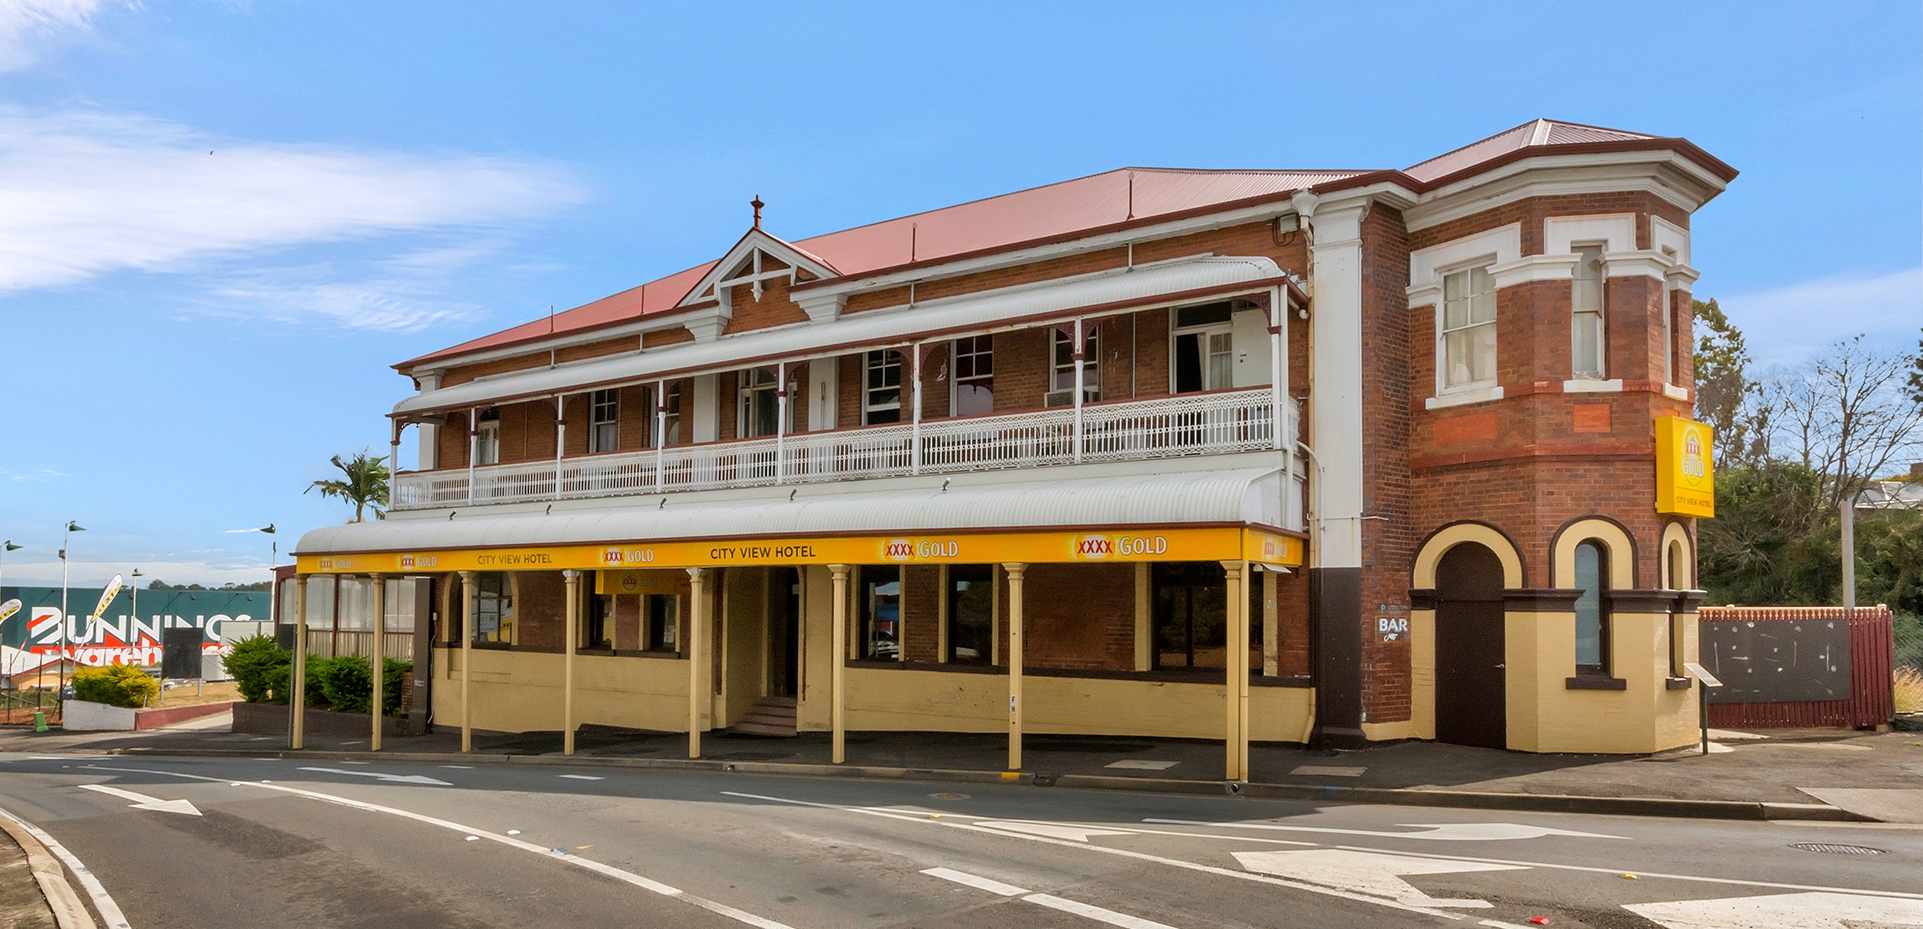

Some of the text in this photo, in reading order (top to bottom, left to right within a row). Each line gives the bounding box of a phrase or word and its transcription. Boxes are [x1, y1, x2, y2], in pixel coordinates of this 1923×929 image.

[1682, 455, 1705, 478] GOLD
[1676, 496, 1712, 508] CITY VIEW HOTEL
[710, 546, 816, 560] CITY VIEW HOTEL
[886, 541, 959, 558] XXXX GOLD
[1078, 536, 1168, 556] XXXX GOLD
[417, 556, 437, 567] GOLD
[477, 553, 553, 565] CITY VIEW HOTEL
[604, 548, 655, 563] XXXX GOLD
[334, 558, 351, 570] GOLD
[1379, 618, 1408, 633] BAR
